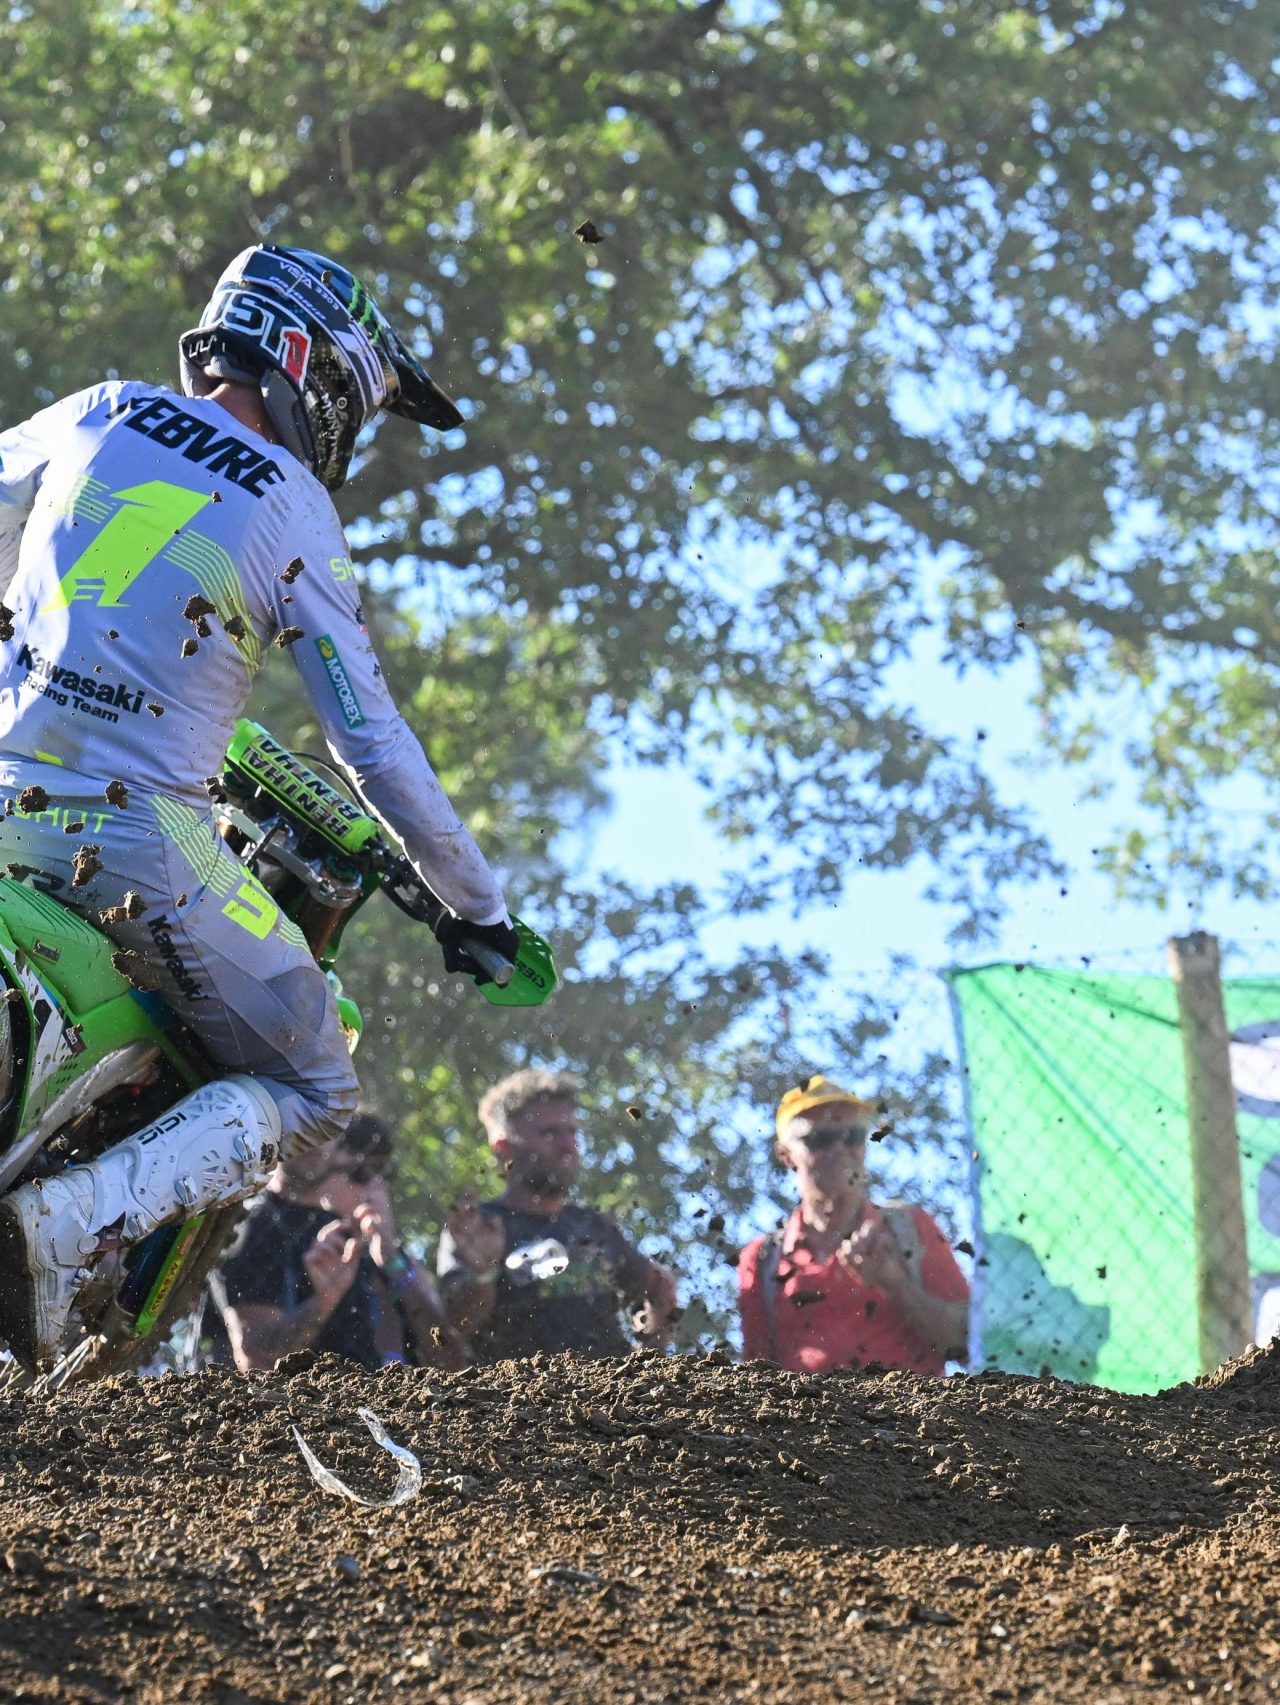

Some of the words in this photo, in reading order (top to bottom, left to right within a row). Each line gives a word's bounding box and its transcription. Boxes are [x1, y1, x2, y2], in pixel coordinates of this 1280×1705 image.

[16, 642, 146, 715] Kawasaki
[22, 672, 69, 707] Racing
[72, 695, 120, 724] Team
[326, 656, 362, 726] MOTOREX
[147, 913, 210, 1003] Kawasaki
